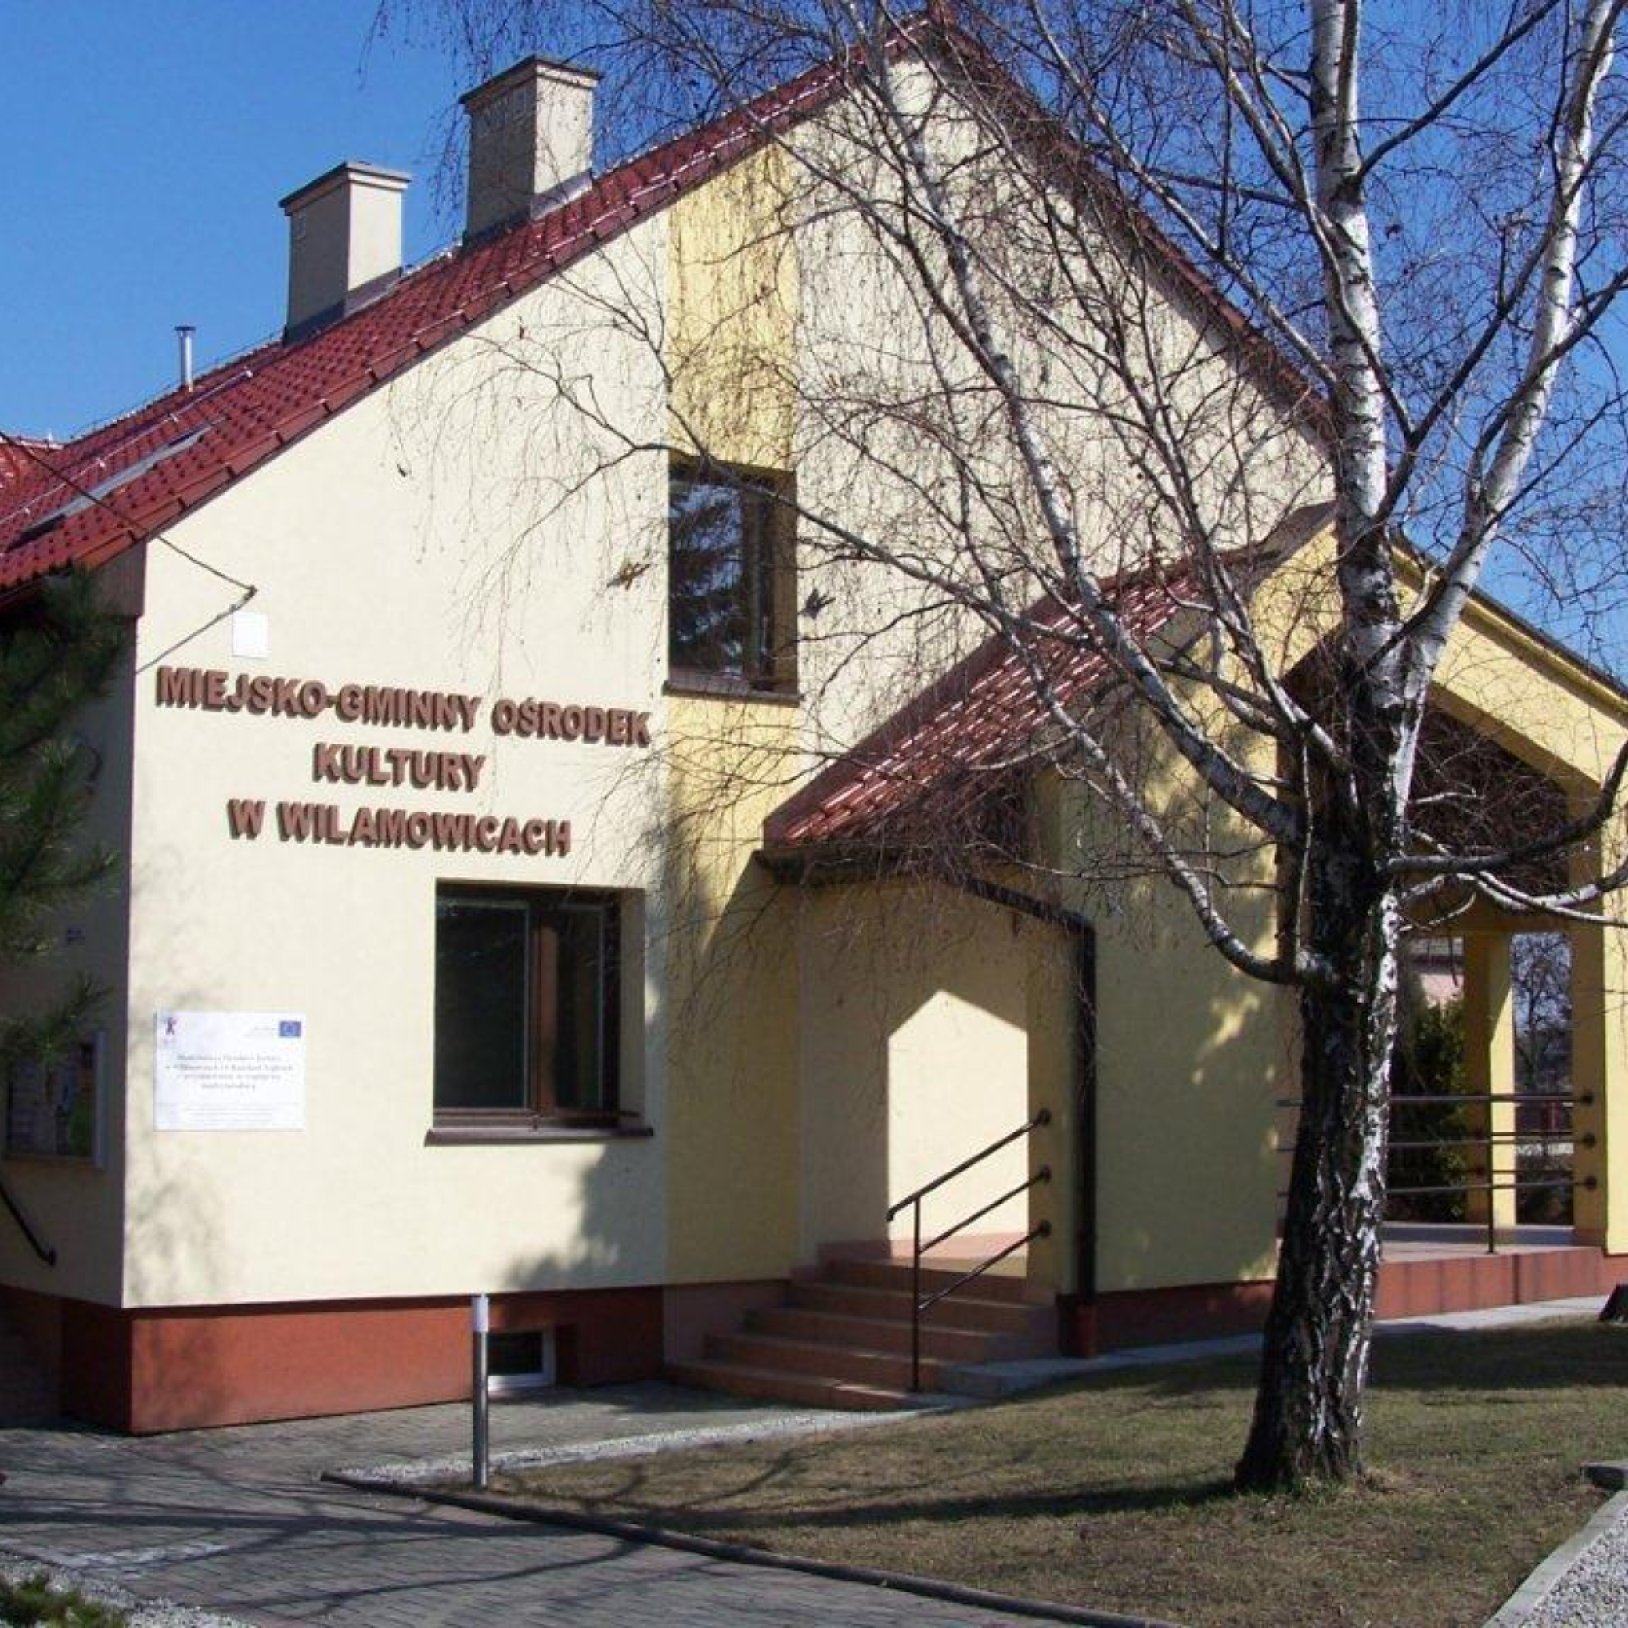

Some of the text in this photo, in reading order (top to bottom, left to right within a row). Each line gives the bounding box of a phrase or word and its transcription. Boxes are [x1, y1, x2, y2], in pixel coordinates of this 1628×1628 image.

[155, 666, 652, 747] MIEJSKO-GMINNY OŚRODEK
[312, 743, 486, 791] KULTURY
[227, 799, 571, 856] W WILAMOWICACH
